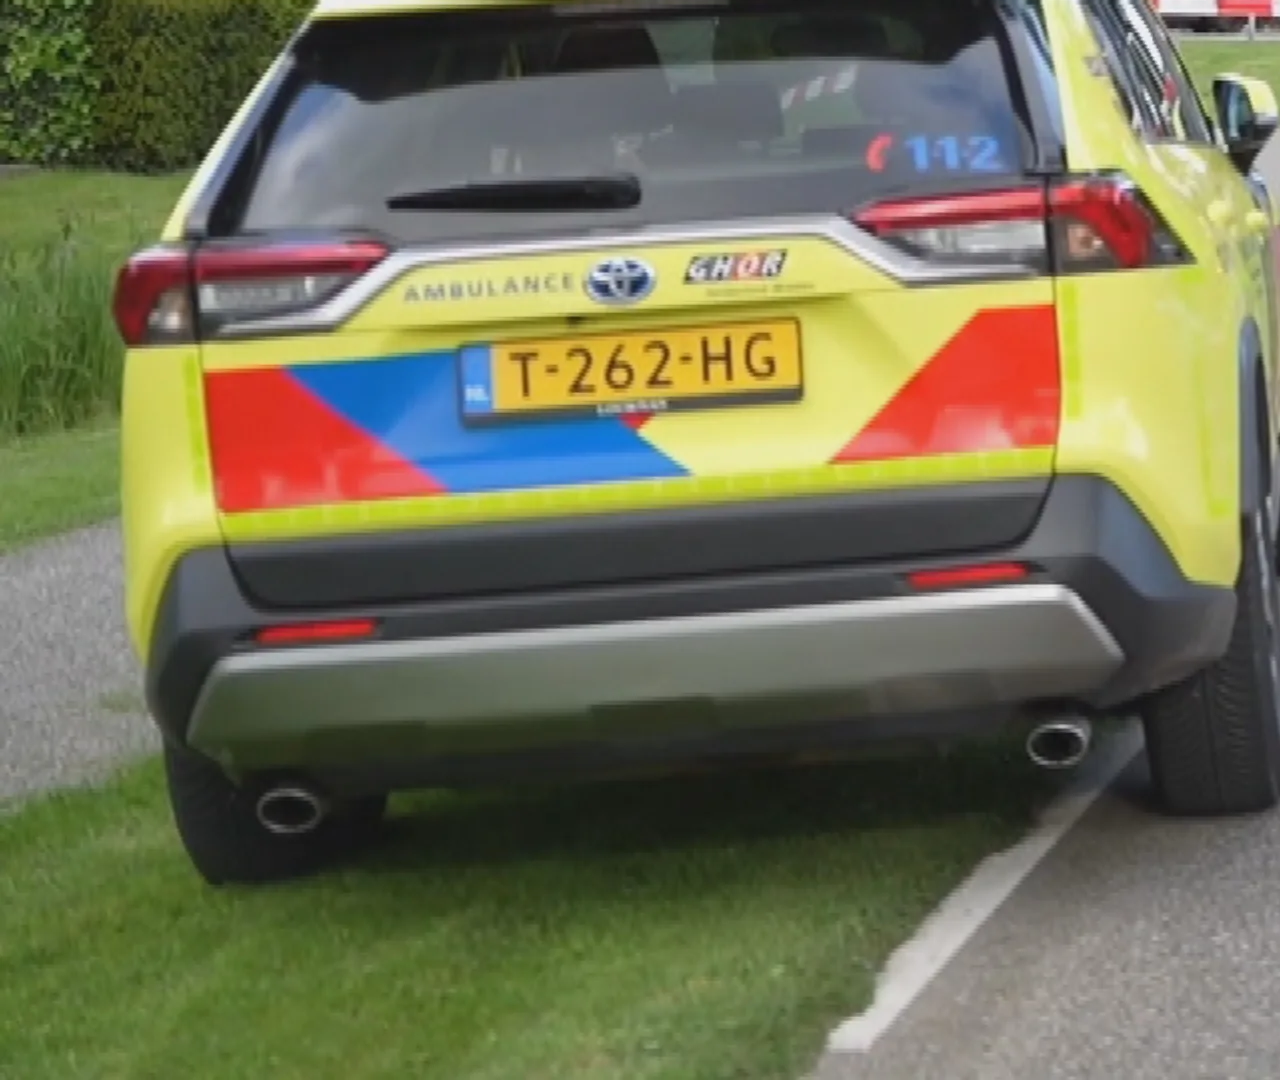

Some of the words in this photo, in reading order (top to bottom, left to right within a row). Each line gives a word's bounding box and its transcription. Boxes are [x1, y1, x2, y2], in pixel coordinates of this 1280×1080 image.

[905, 135, 1004, 171] 112
[688, 250, 787, 283] GHOR
[402, 272, 575, 303] AMBULANCE
[508, 331, 777, 398] T-262-HG
